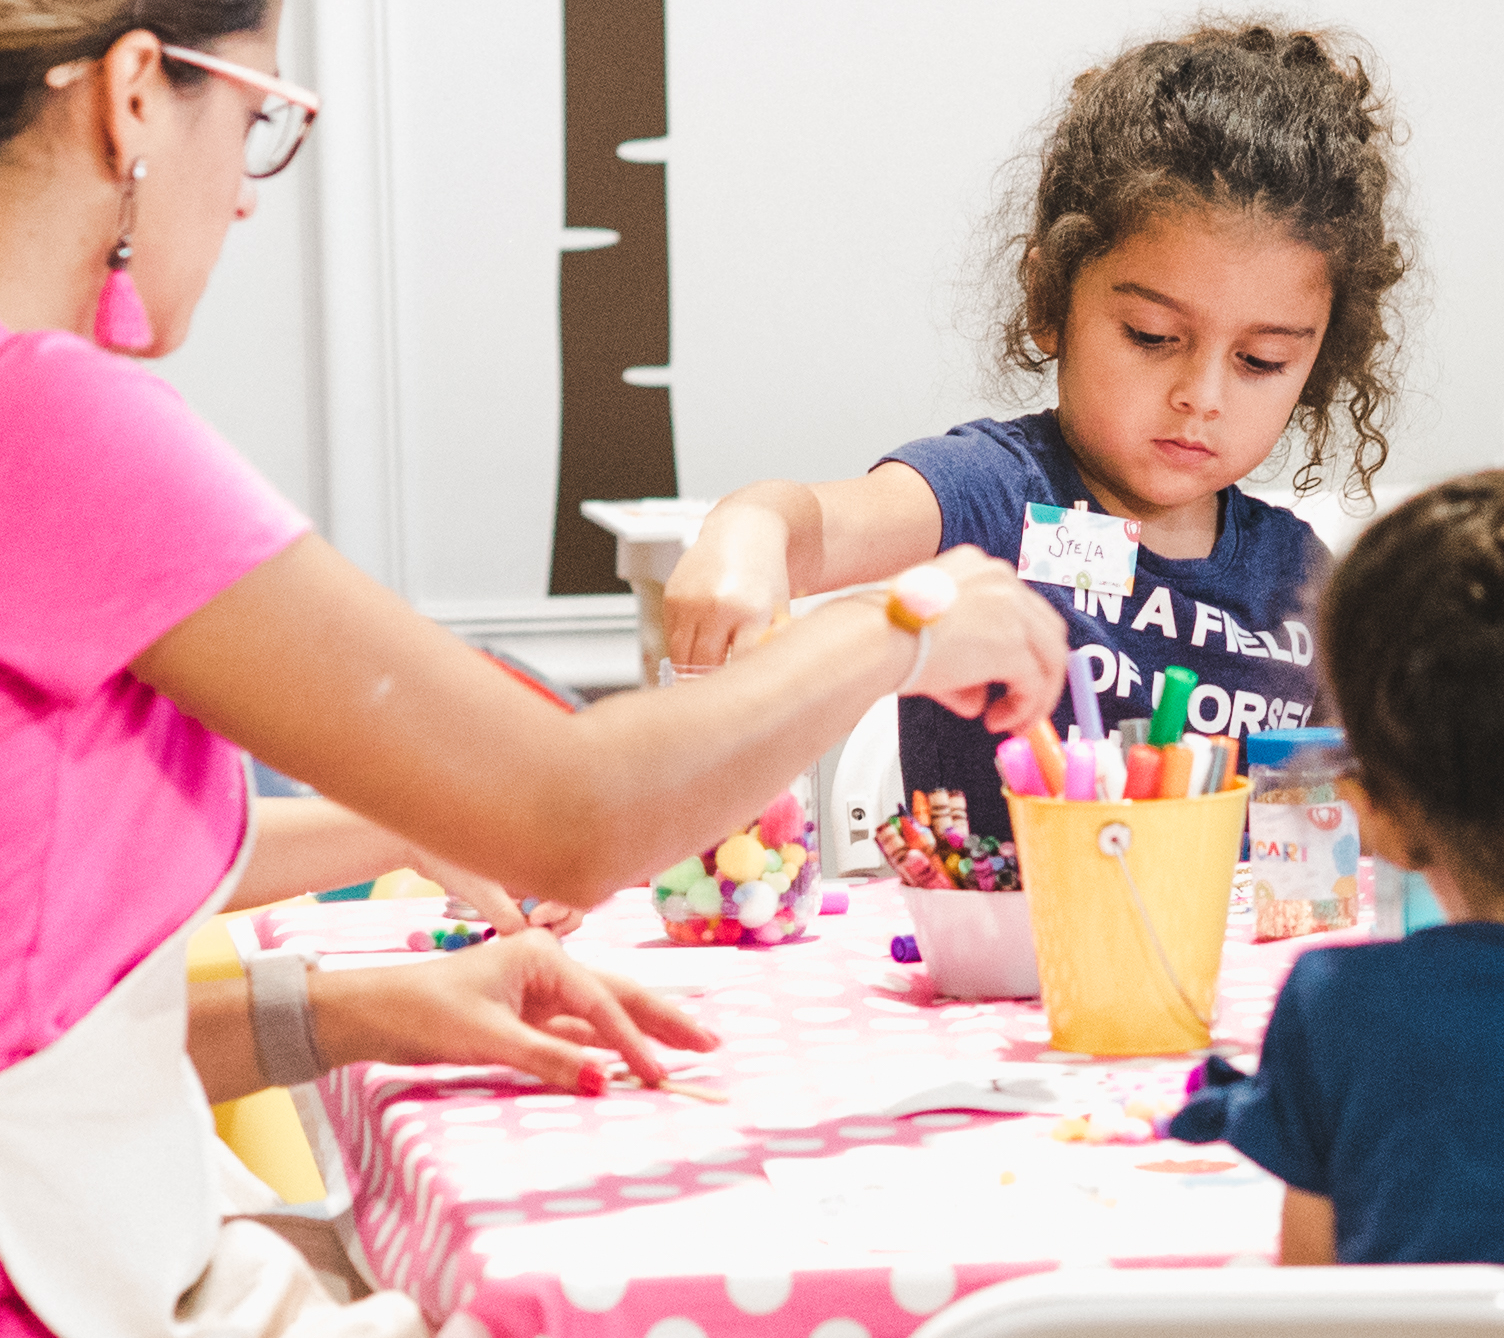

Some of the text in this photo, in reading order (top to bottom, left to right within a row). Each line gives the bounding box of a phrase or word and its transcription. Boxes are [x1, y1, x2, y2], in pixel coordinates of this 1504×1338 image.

[1130, 586, 1178, 639] A
[1190, 601, 1314, 667] FIELD
[1076, 643, 1143, 698] OF
